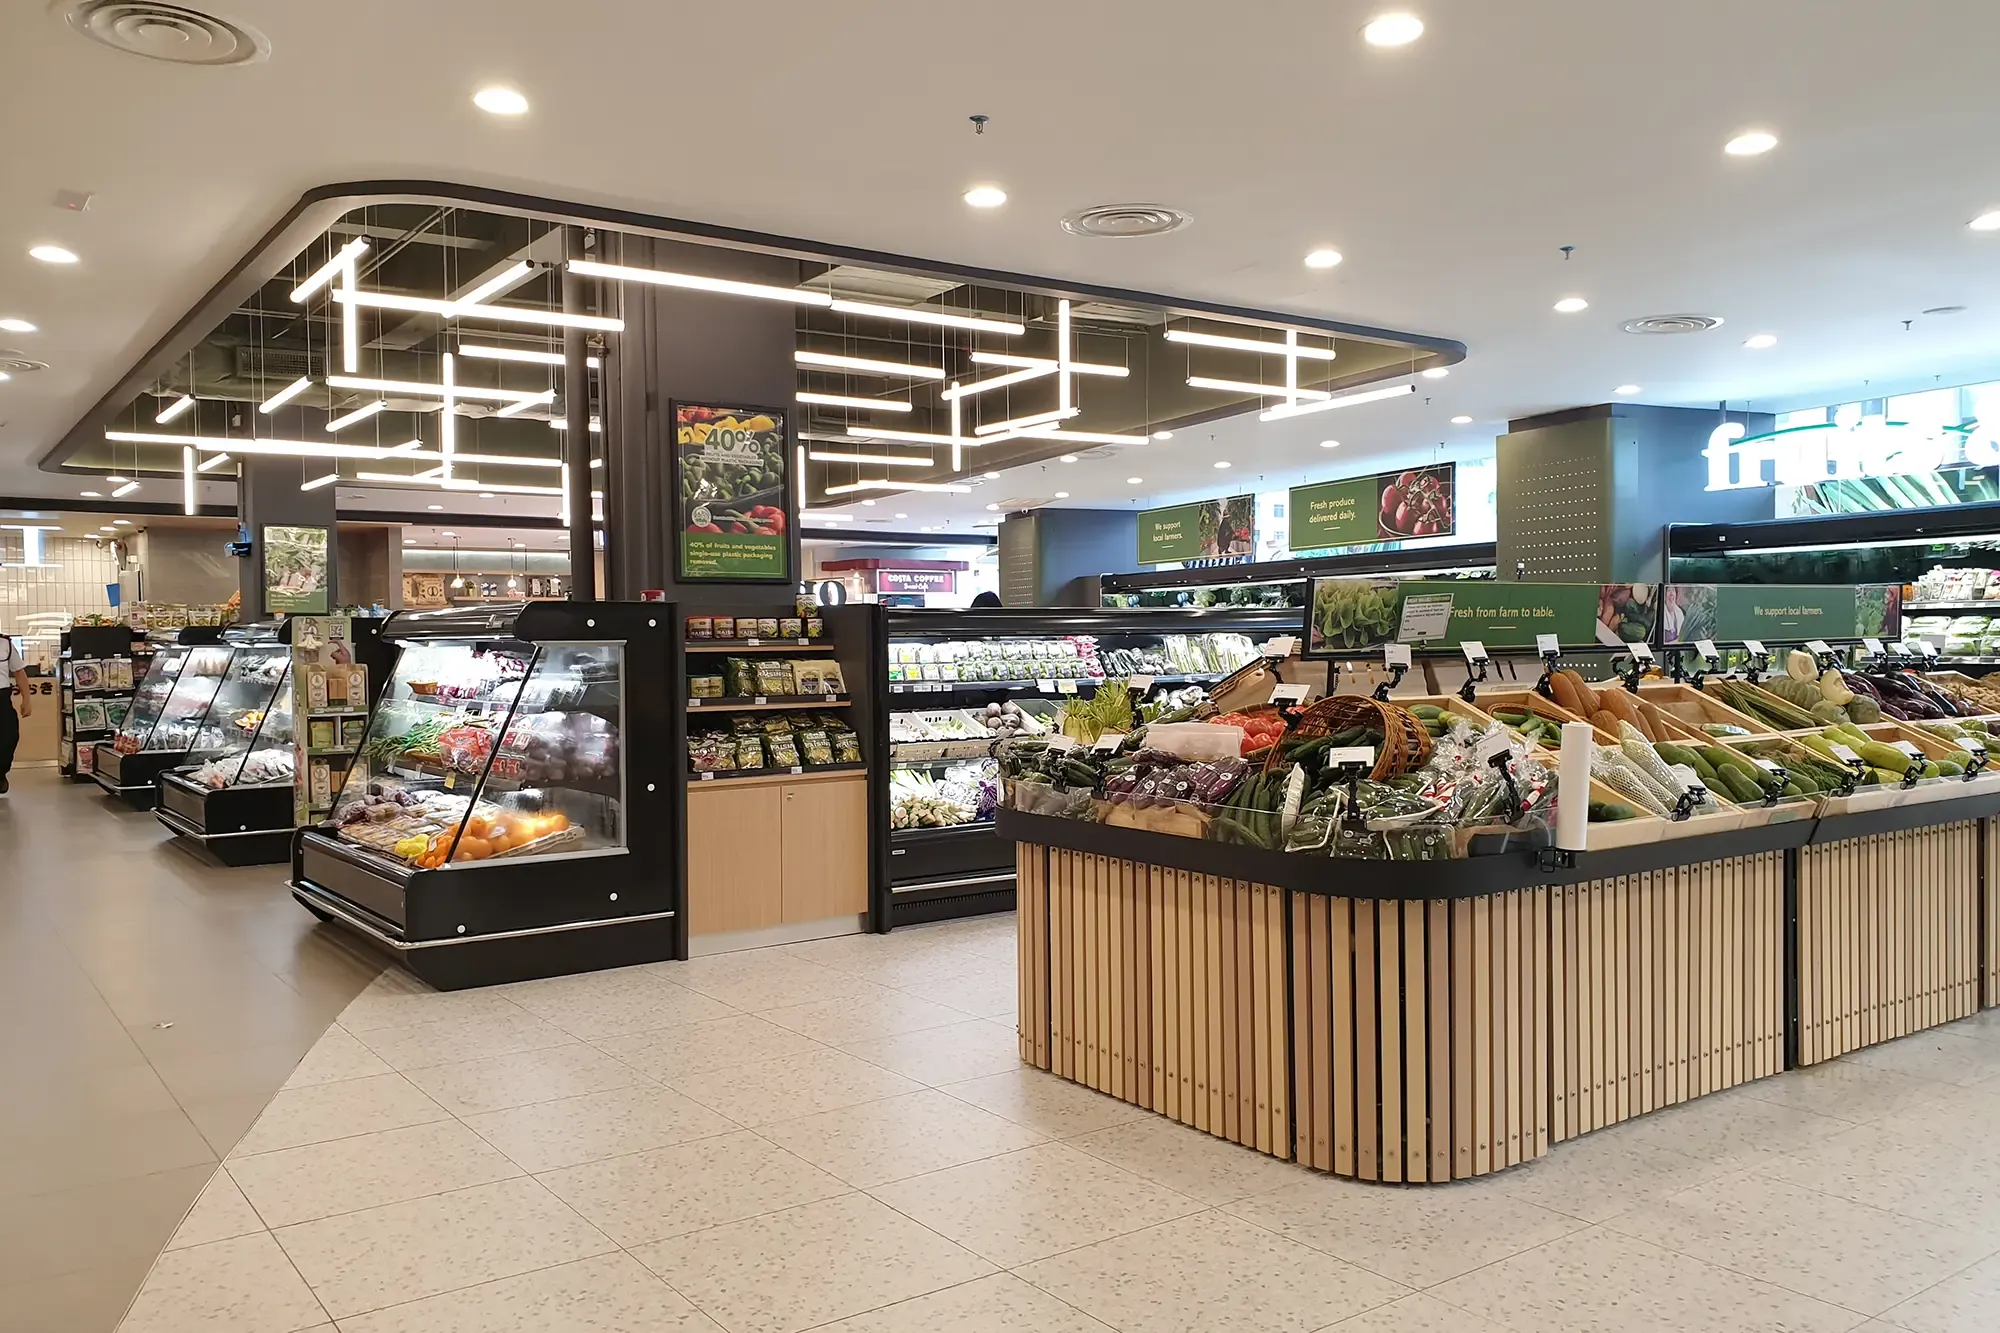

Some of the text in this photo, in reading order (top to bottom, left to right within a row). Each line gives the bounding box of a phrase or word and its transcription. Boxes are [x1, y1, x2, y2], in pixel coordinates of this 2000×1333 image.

[705, 428, 760, 453] 40%
[1310, 497, 1355, 511] Fresh produce
[1309, 509, 1356, 523] delivered daily.
[1154, 520, 1181, 531] We support
[1152, 533, 1164, 542] local
[689, 550, 721, 558] single-use
[743, 552, 774, 560] packaging
[887, 574, 944, 583] COSTA COFFEE
[1450, 606, 1555, 618] Fresh from farm to table.
[1753, 605, 1824, 618] We support local farmers.
